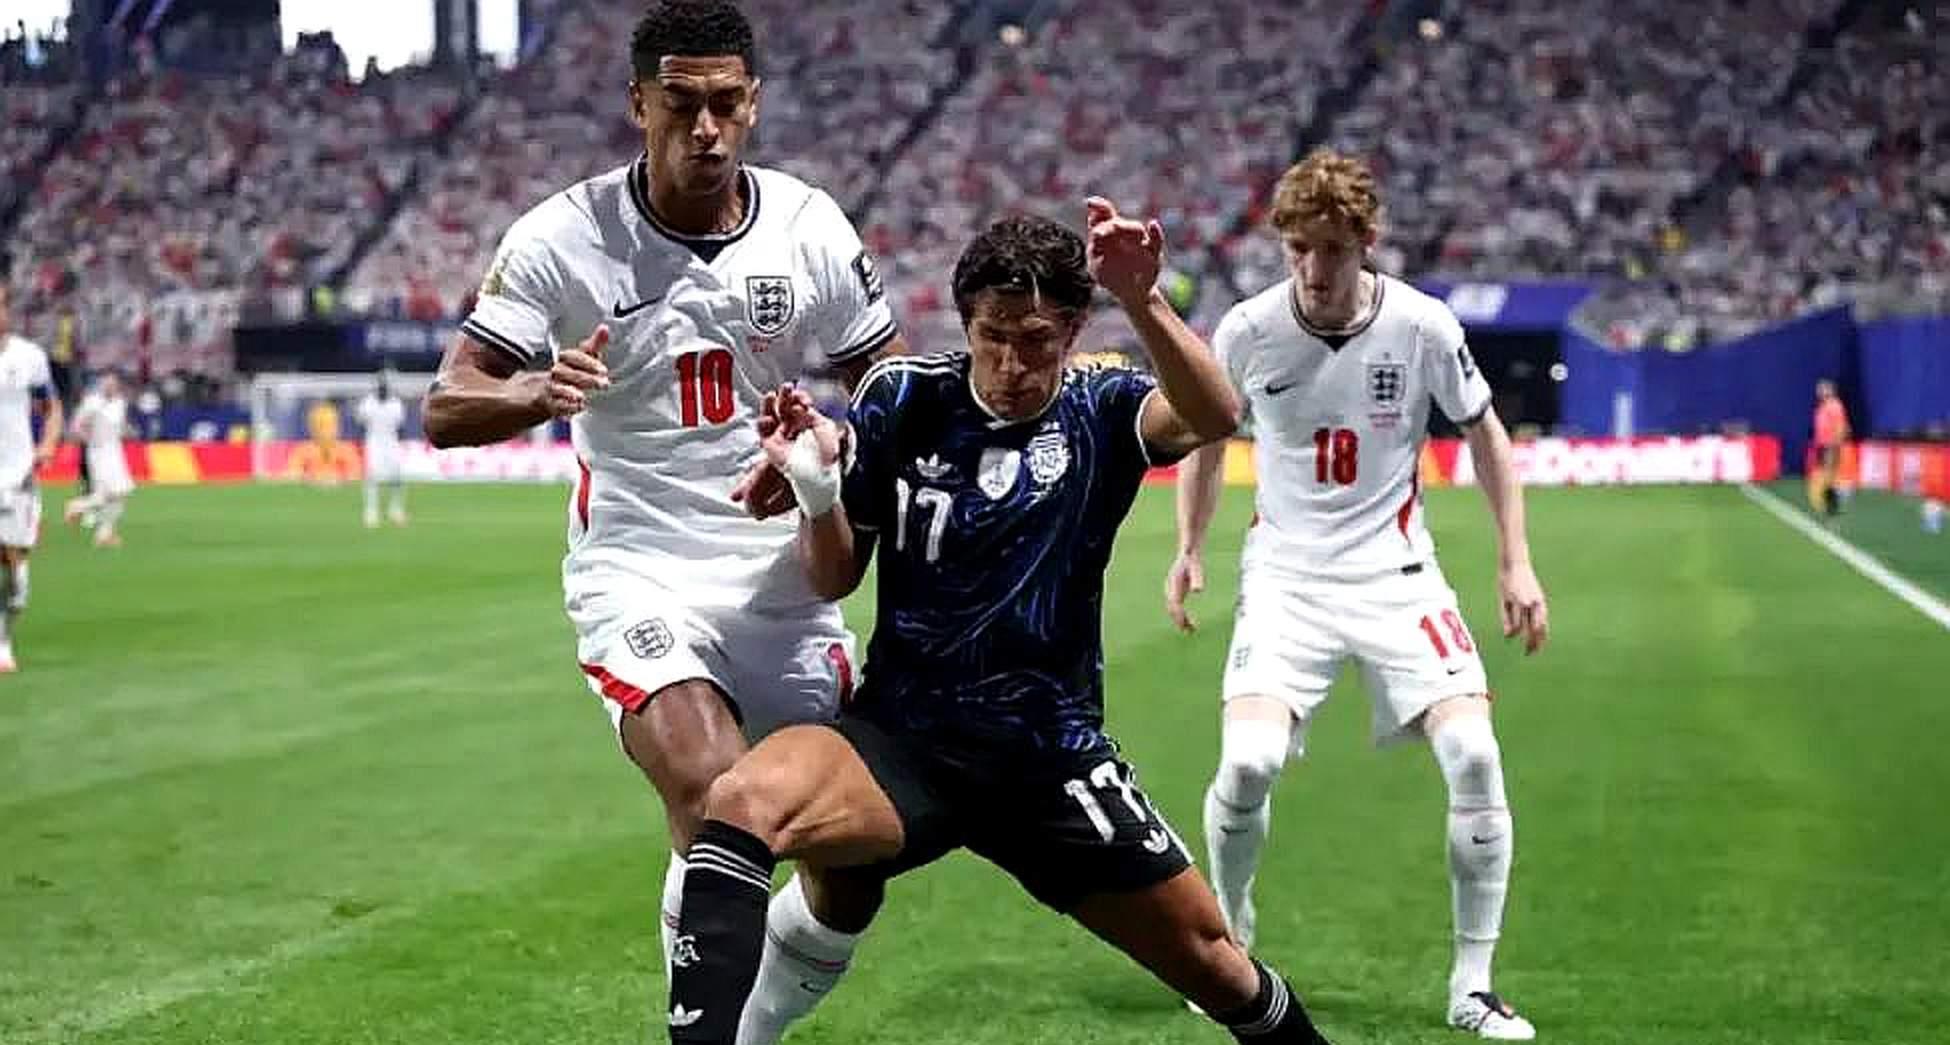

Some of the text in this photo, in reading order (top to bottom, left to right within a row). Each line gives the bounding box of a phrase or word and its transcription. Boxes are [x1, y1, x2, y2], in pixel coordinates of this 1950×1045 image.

[676, 349, 735, 427] 10
[1313, 427, 1359, 485] 18
[896, 477, 953, 563] 17
[1418, 608, 1473, 659] 18
[1064, 760, 1148, 843] 17
